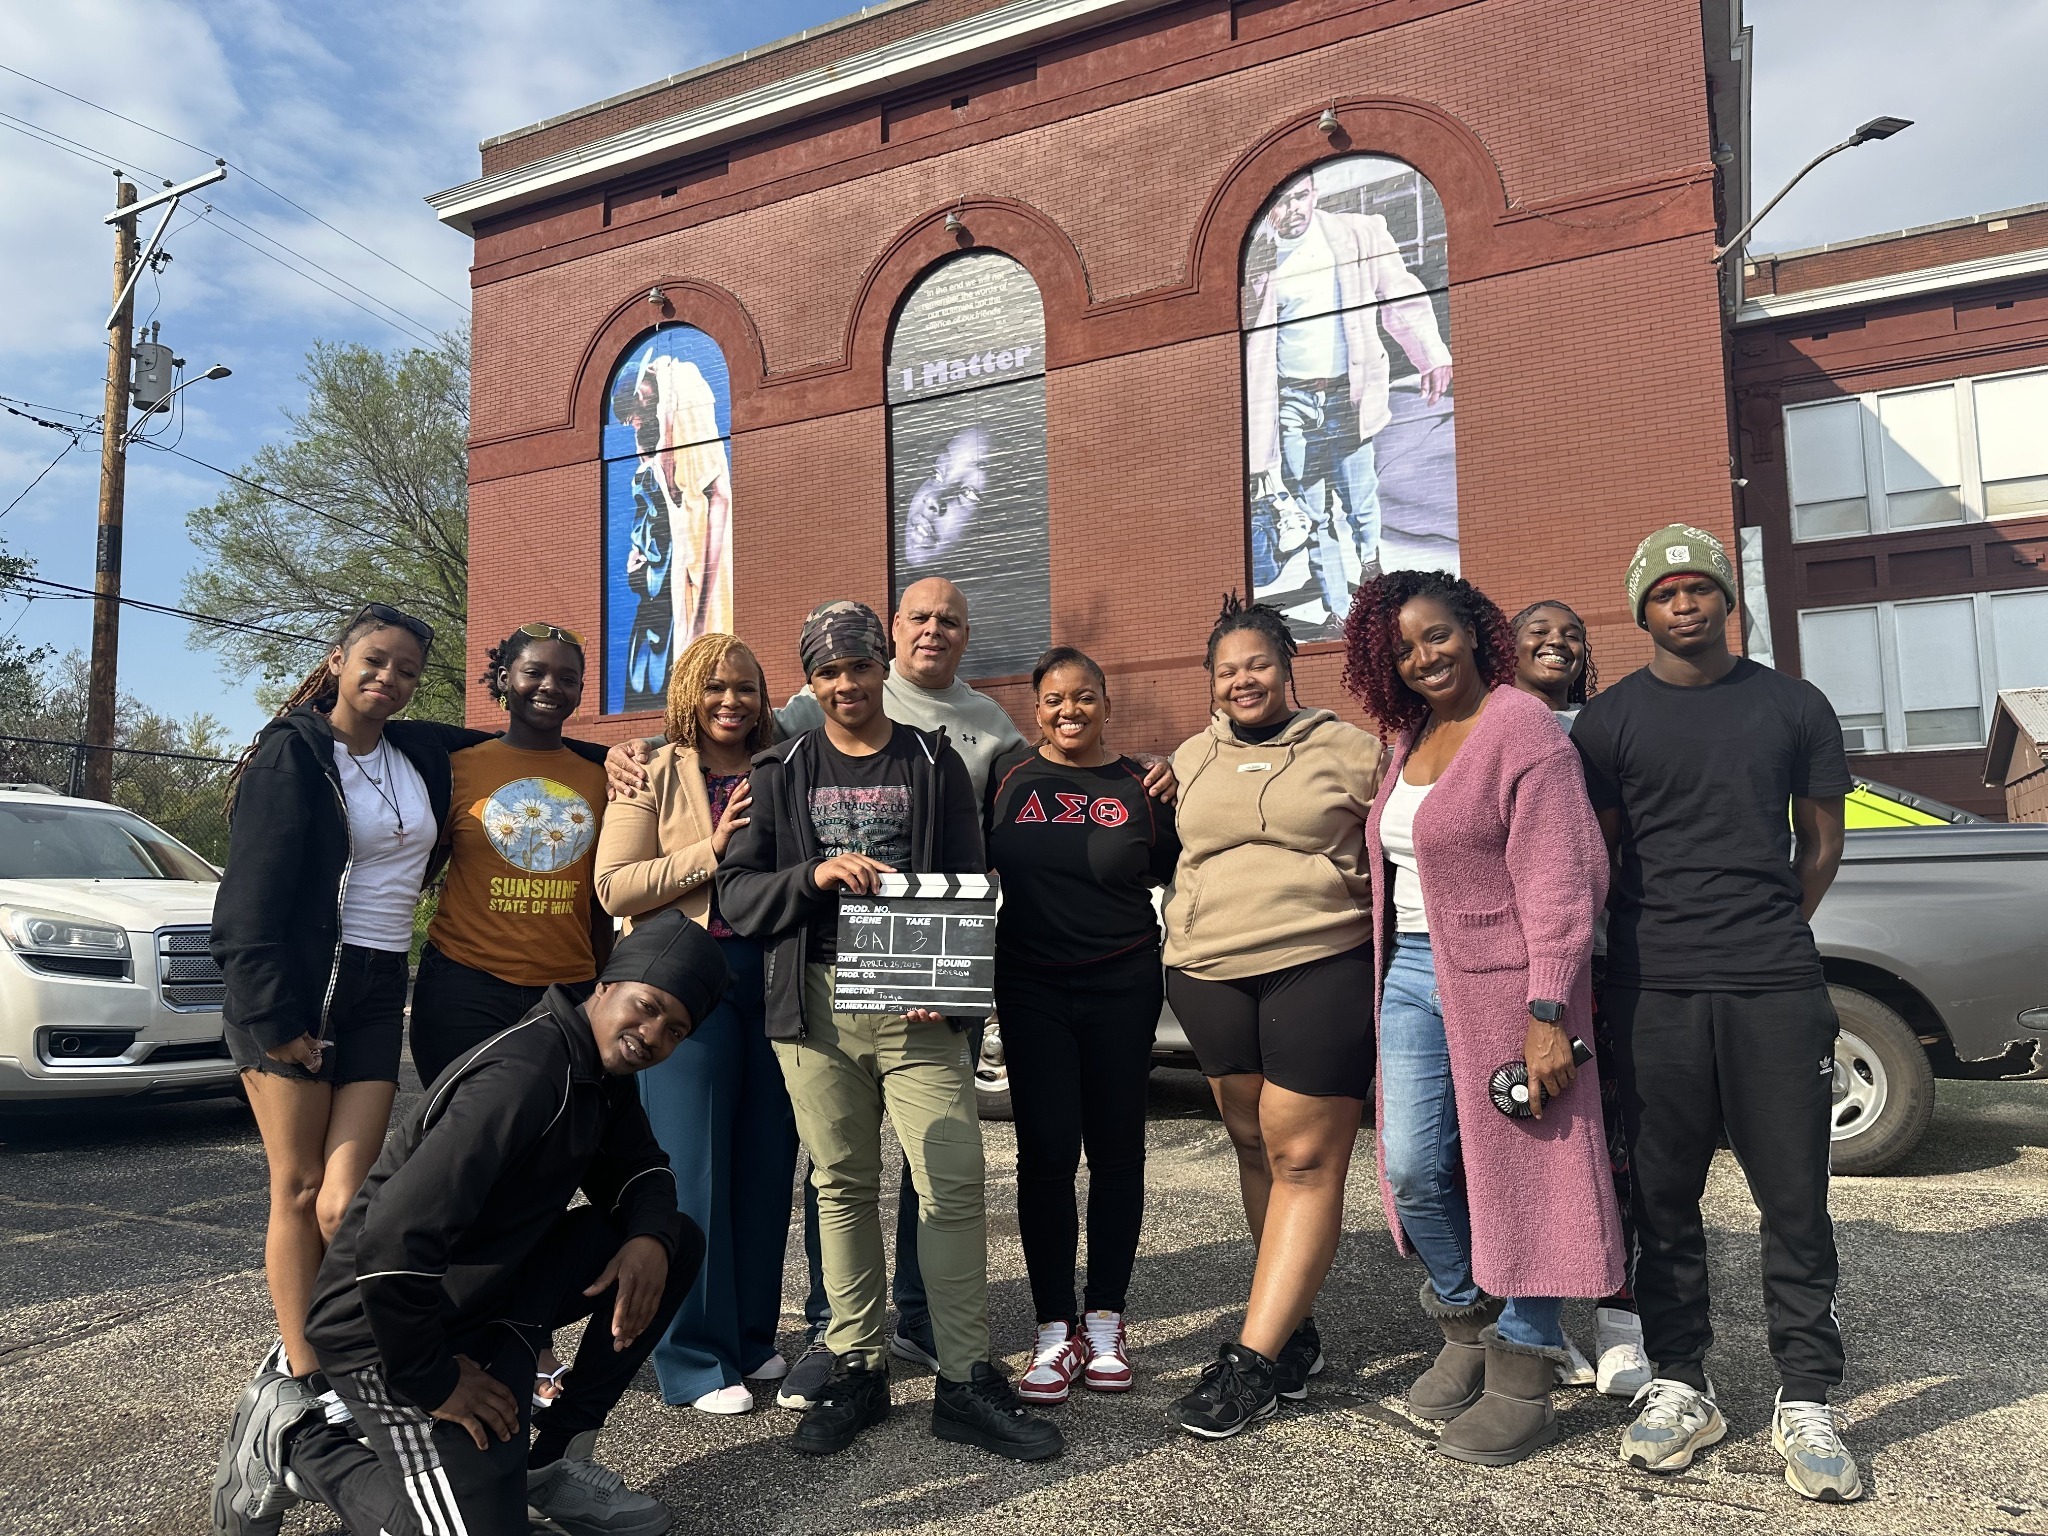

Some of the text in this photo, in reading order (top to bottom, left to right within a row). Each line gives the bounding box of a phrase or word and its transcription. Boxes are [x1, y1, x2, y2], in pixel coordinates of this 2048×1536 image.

[935, 285, 947, 296] the
[949, 280, 963, 292] end
[965, 279, 976, 288] we
[977, 274, 991, 285] will
[992, 271, 1005, 281] not
[920, 280, 1008, 312] remember the words of
[903, 346, 1032, 391] I Matter
[811, 805, 827, 816] EVI
[831, 801, 878, 813] STRAUSS
[490, 876, 581, 898] SUNSHINE
[489, 898, 574, 915] STATE OF MIN
[841, 904, 870, 913] PROD.
[849, 915, 883, 924] SCENE
[906, 918, 931, 926] TAKE
[959, 919, 984, 927] ROLL
[910, 930, 928, 952] 3
[837, 955, 858, 963] DATE
[936, 958, 971, 968] SOUND
[835, 987, 876, 995] DIRECTOR
[834, 1002, 886, 1011] CAMERAMAN
